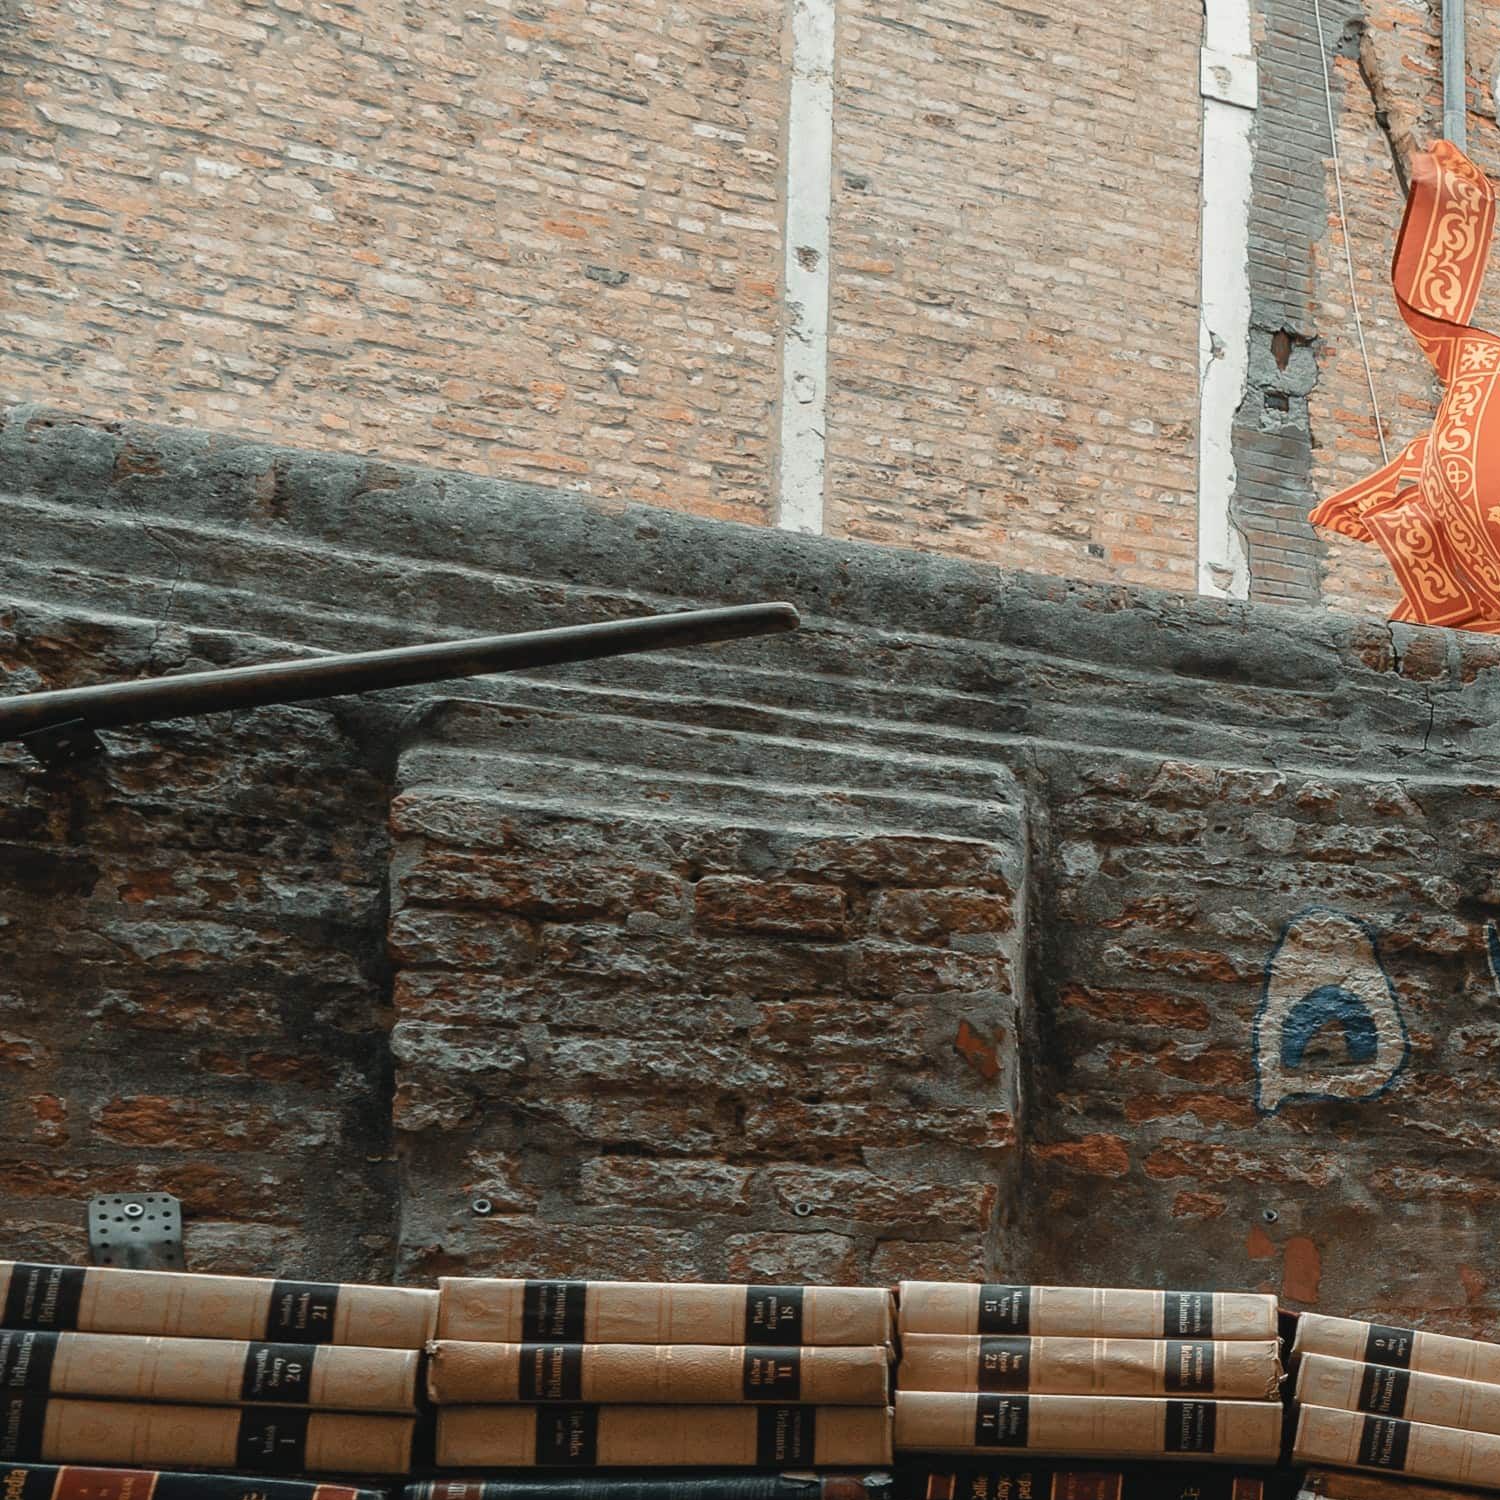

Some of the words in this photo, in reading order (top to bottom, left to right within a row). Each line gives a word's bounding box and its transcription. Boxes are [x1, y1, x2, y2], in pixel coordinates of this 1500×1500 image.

[38, 1267, 62, 1323] Britannica
[550, 1284, 567, 1337] Britannica
[780, 1305, 794, 1321] 18
[984, 1299, 998, 1313] 15
[1178, 1294, 1191, 1334] Britannica
[10, 1332, 36, 1387] Britannica
[286, 1362, 302, 1381] 20
[548, 1347, 564, 1399] Britannica
[984, 1353, 998, 1369] 23
[1179, 1344, 1193, 1385] Britannica
[1380, 1371, 1397, 1413] Britannica
[1380, 1420, 1397, 1464] Britannica
